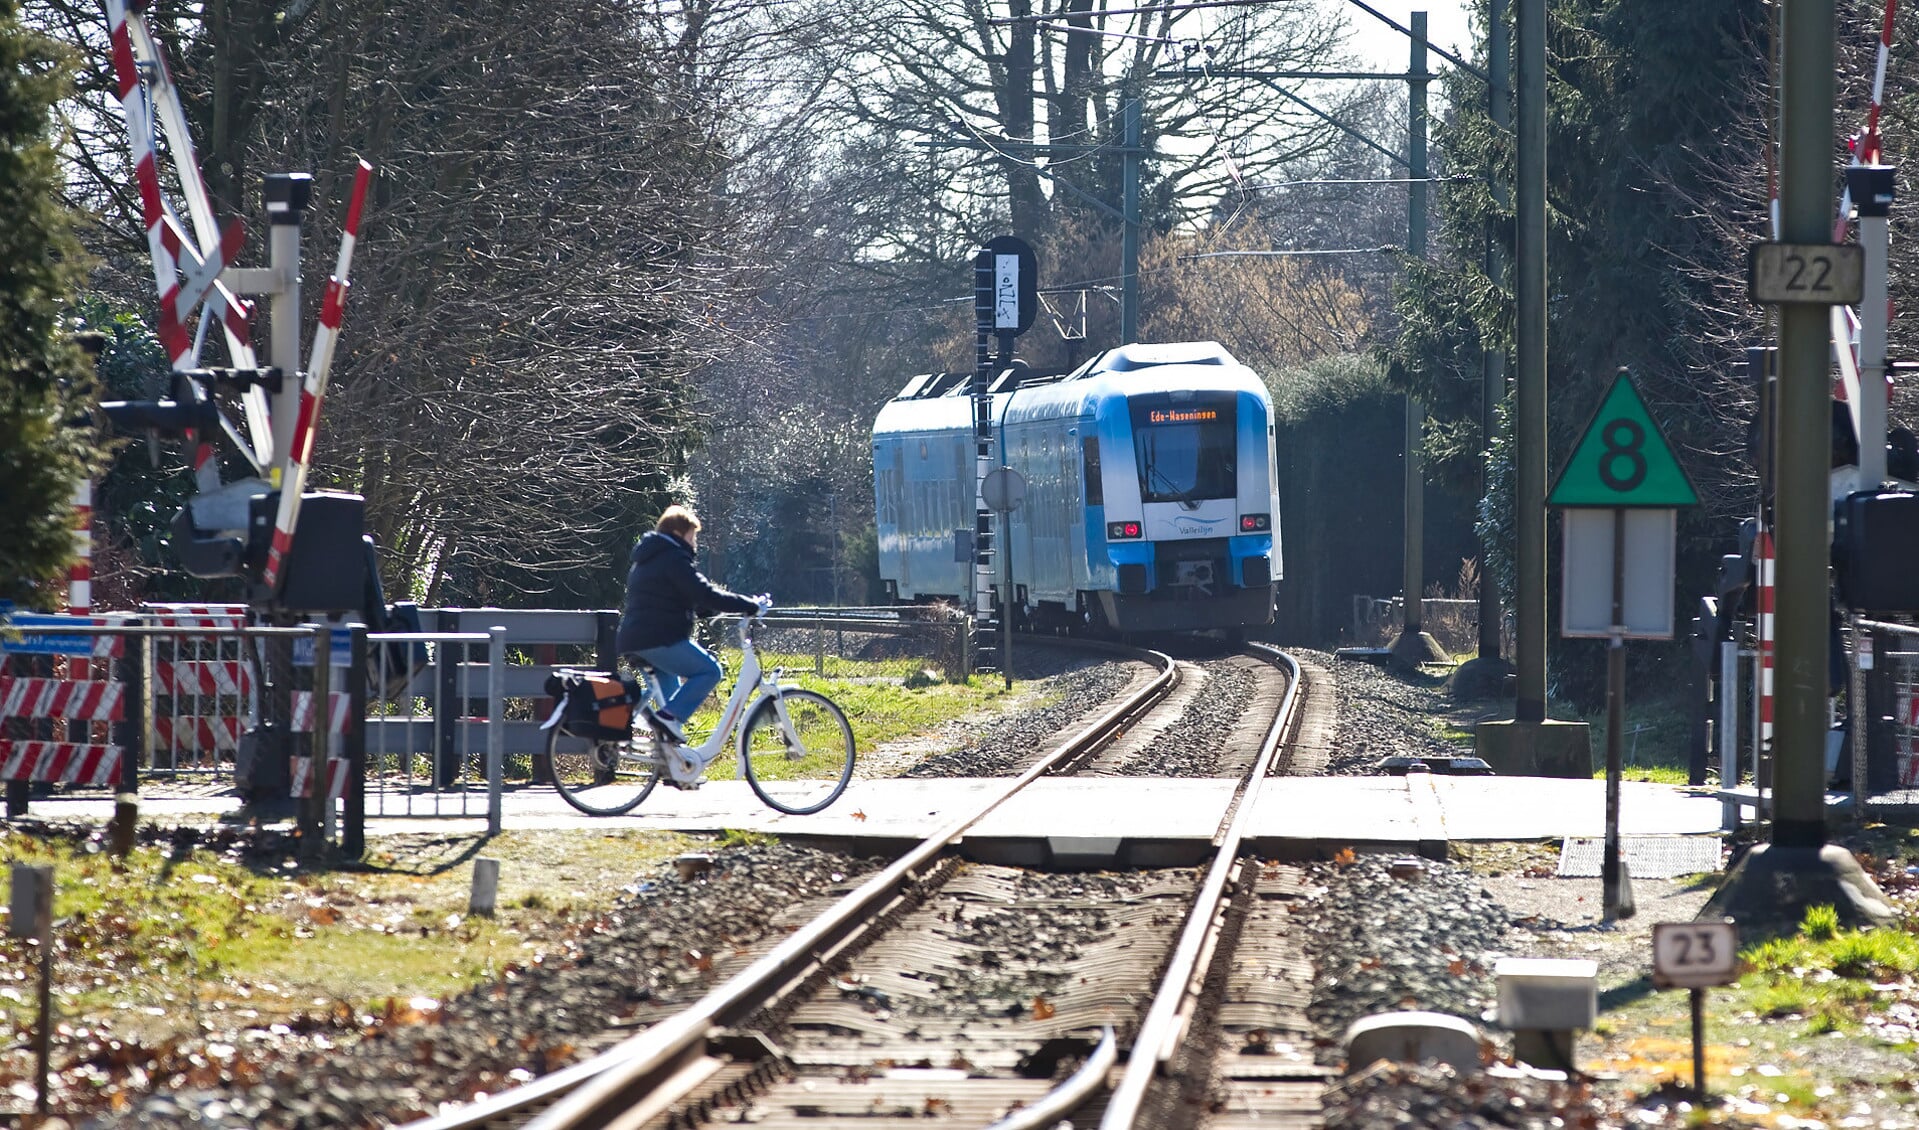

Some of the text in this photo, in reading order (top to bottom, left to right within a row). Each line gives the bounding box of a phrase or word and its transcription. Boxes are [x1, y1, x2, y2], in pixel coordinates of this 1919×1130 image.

[1785, 254, 1833, 291] 22
[1598, 417, 1648, 492] 8
[1671, 931, 1716, 965] 23
